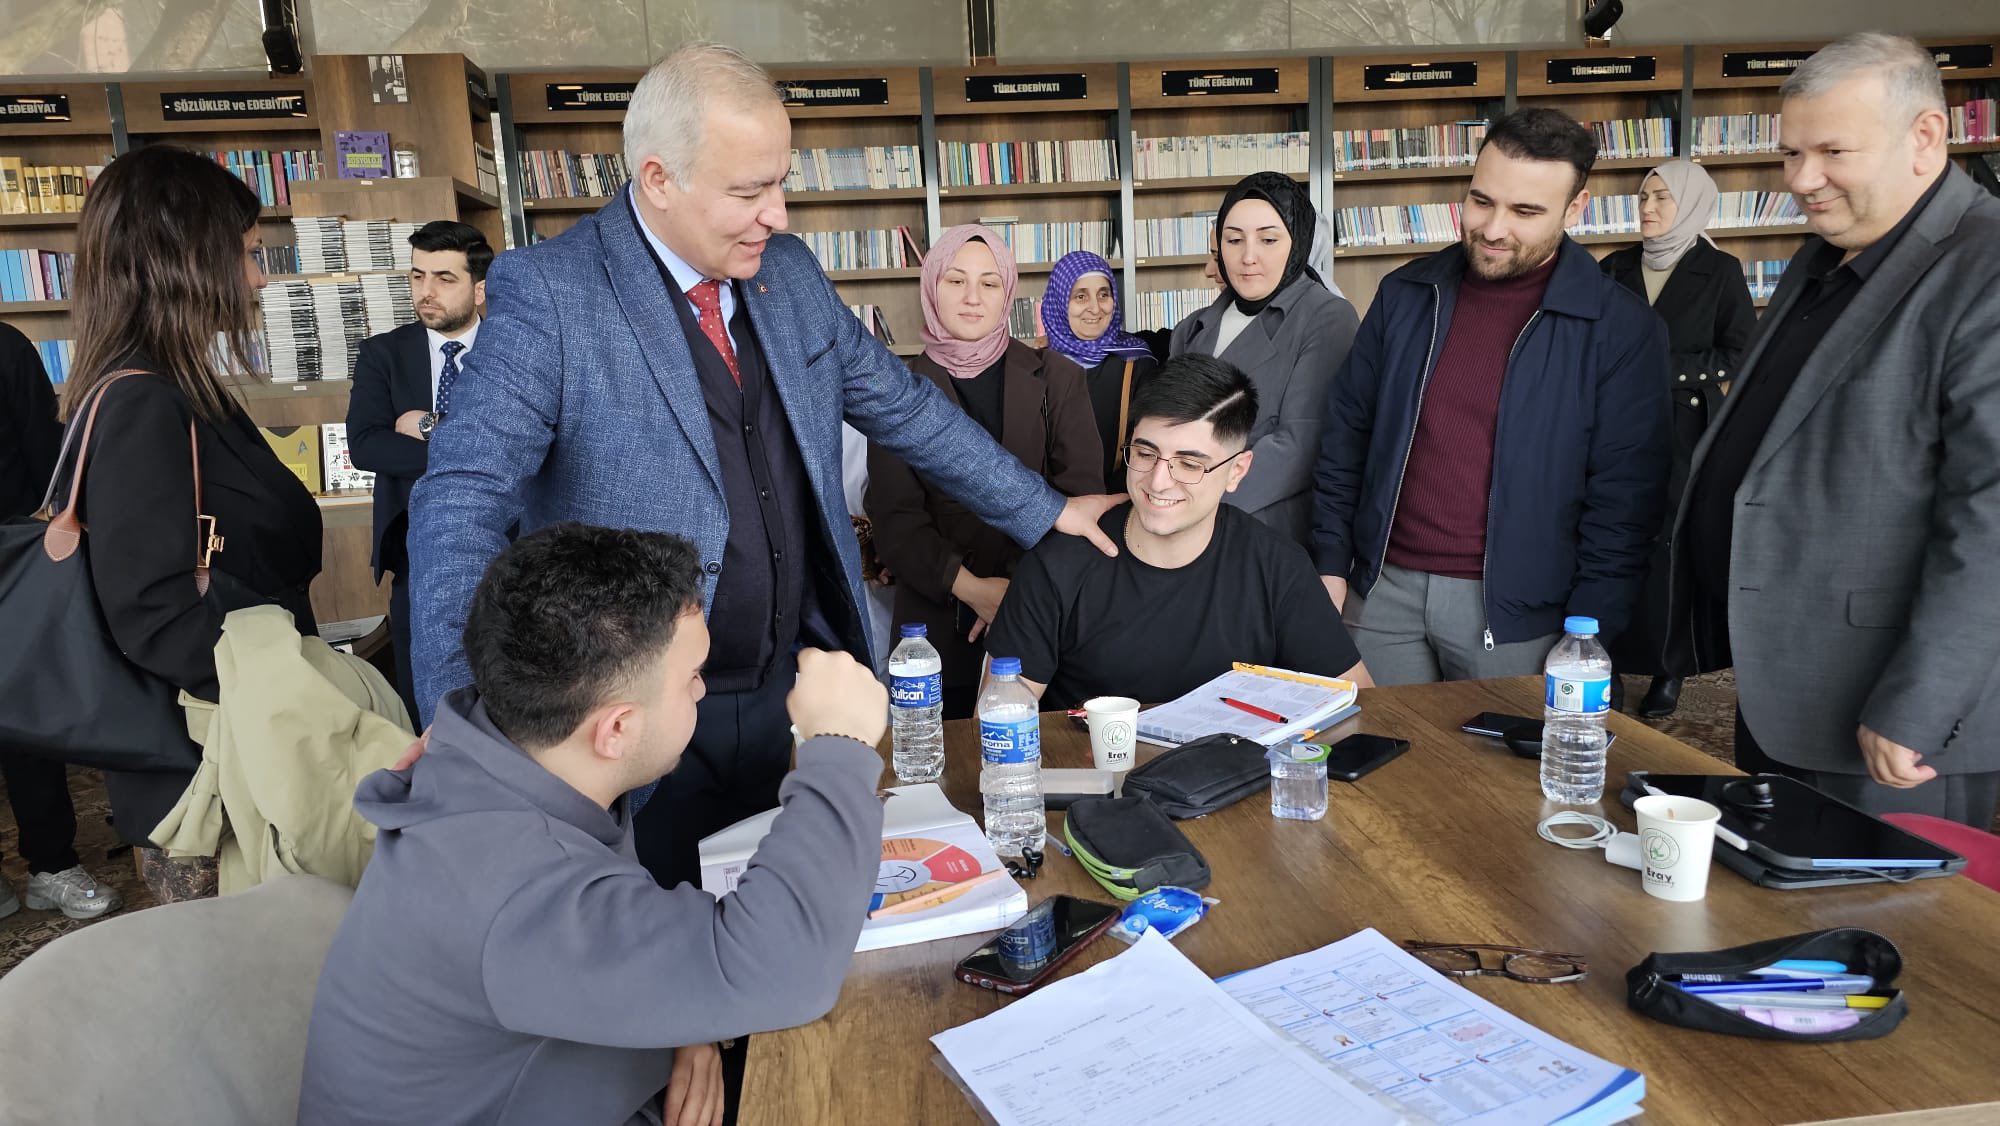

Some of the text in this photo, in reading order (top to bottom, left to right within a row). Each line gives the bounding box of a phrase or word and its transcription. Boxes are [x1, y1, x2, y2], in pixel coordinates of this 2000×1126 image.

[1571, 64, 1631, 76] TÜRK EDEBİYATI
[1746, 59, 1767, 70] TÜRK
[1390, 70, 1452, 81] TÜRK EDEBİYATI
[993, 82, 1060, 94] TÜRK EDEBİYATI
[1188, 76, 1253, 88] TÜRK EDEBİYATI
[577, 91, 602, 102] TÜRK
[791, 86, 860, 99] TÜRK EDEBİYATI
[8, 102, 57, 114] EDEBİYAT
[174, 97, 293, 112] SÖZLÜKLER ve EDEBİYAT
[891, 687, 924, 701] Sultan
[1108, 751, 1128, 760] Eray
[1646, 866, 1672, 883] Eray
